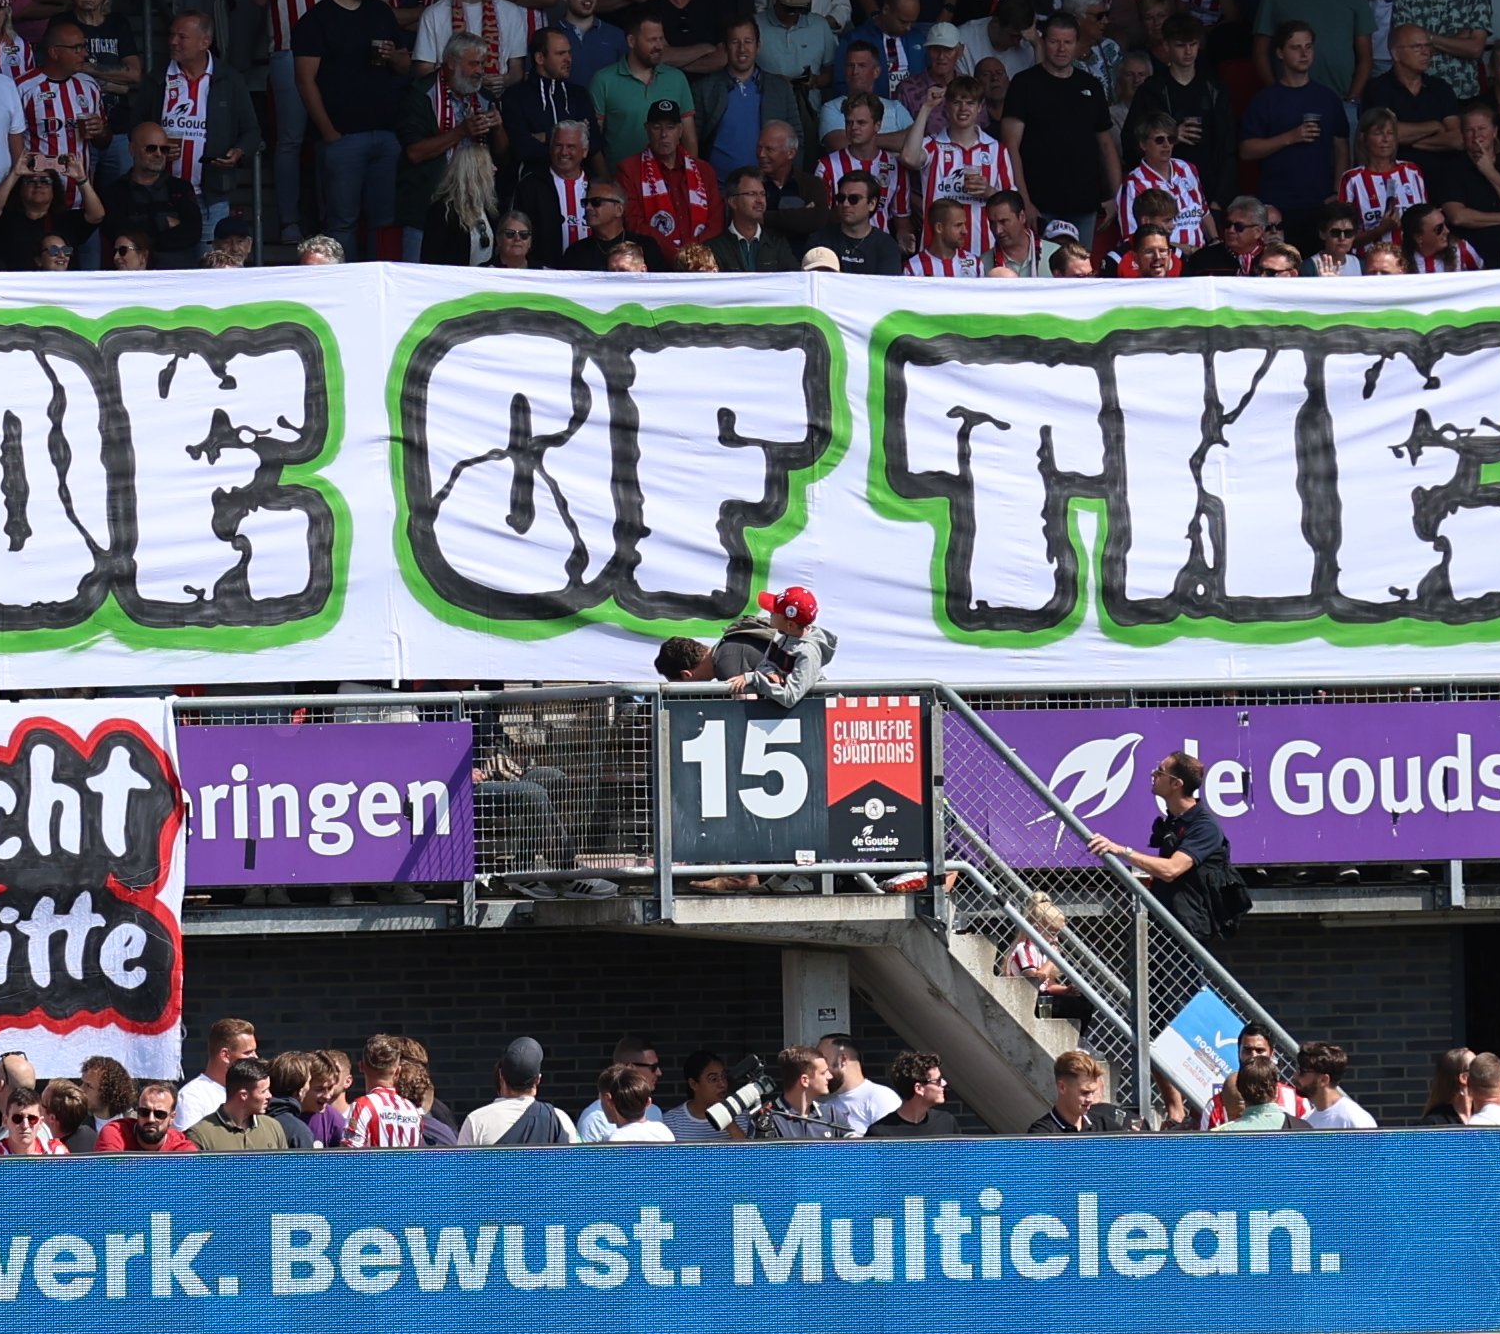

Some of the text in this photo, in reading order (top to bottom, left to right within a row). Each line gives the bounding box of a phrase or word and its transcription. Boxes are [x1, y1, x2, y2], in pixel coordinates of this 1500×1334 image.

[159, 118, 171, 128] de
[833, 720, 914, 741] CLUBLIEFDE
[833, 742, 915, 765] SPARTAANS
[681, 718, 810, 820] 15
[182, 762, 452, 857] ringen
[852, 835, 899, 846] de Goudse
[270, 1204, 703, 1296] Bewust.
[731, 1186, 1342, 1289] Multiclean.
